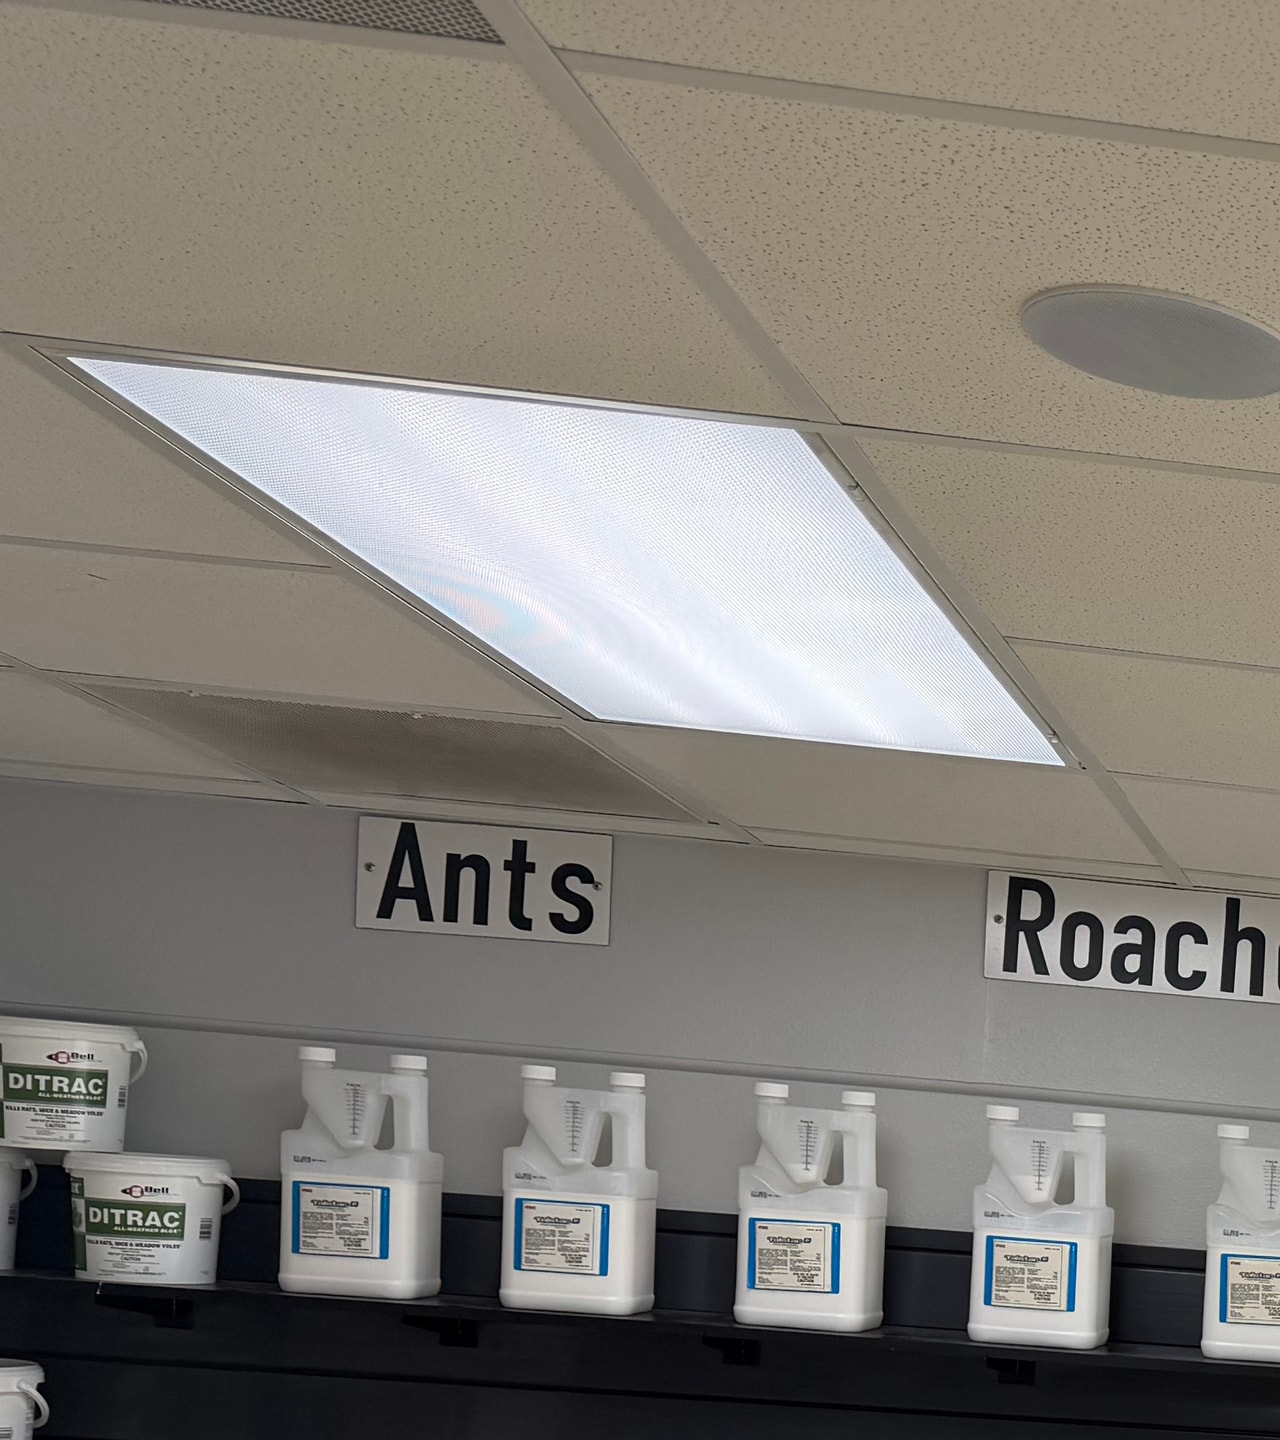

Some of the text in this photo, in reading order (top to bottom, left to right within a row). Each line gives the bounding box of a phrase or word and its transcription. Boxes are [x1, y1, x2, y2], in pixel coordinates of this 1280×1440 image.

[376, 821, 597, 935] Ants
[70, 1051, 95, 1062] Bell
[8, 1072, 105, 1095] DITRAC
[144, 1186, 169, 1195] Bell
[89, 1206, 181, 1228] DITRAC
